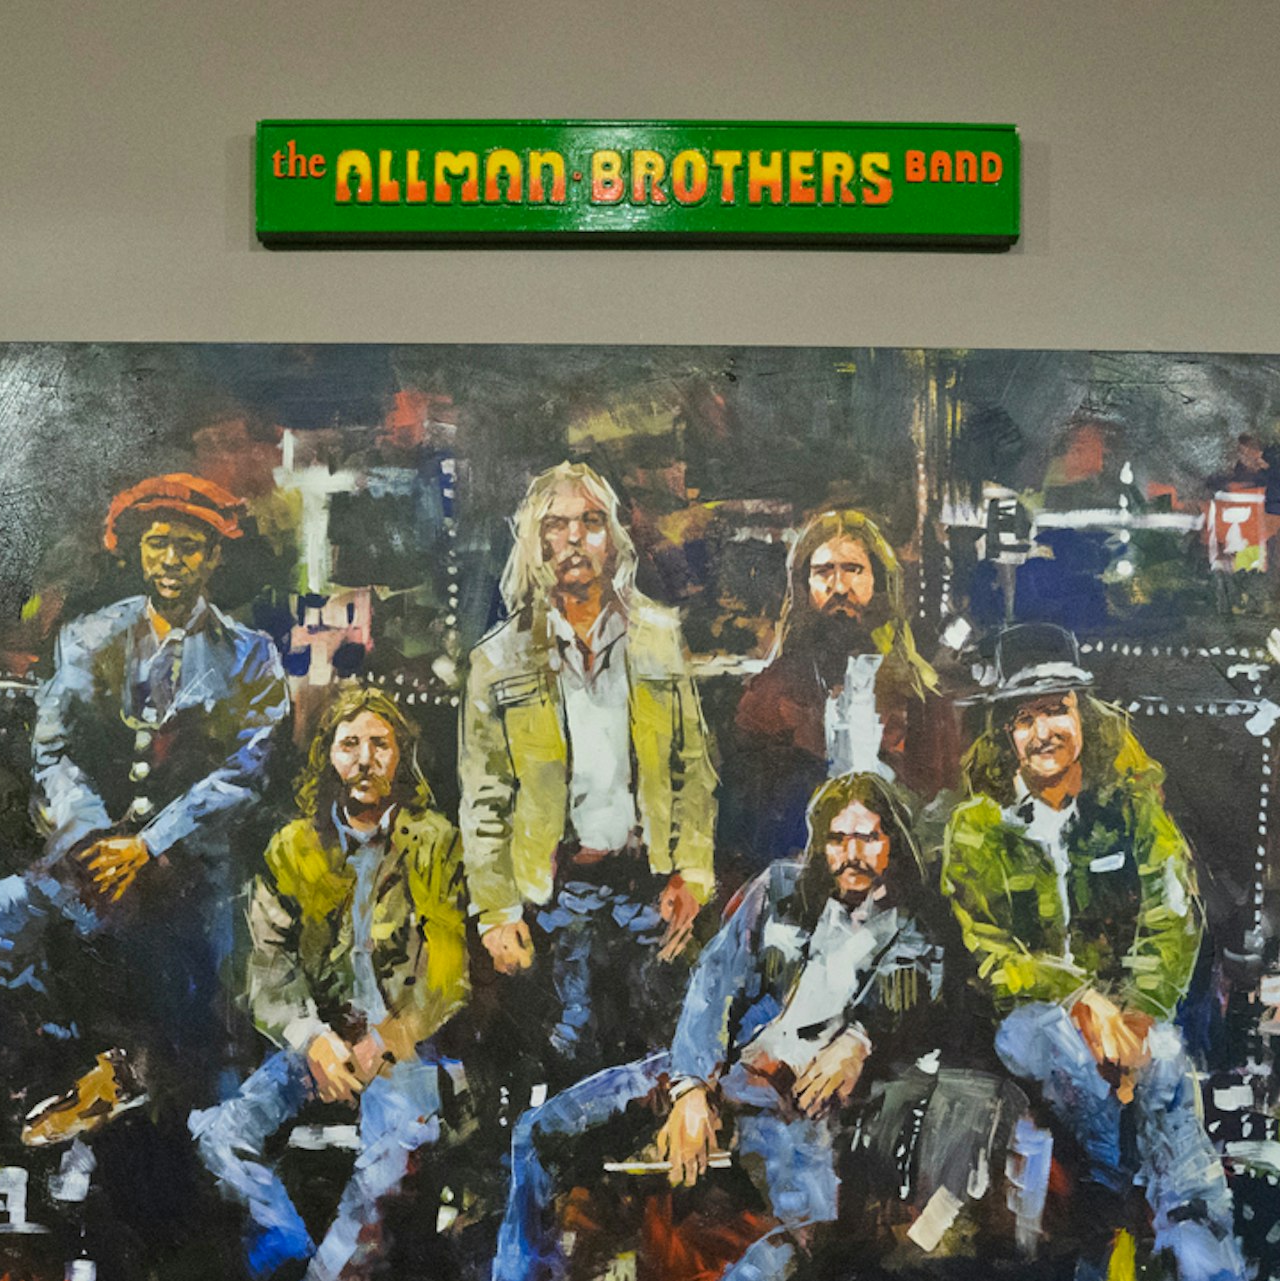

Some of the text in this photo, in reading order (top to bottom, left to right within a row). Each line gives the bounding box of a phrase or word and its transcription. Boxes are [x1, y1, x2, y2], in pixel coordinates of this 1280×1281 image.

[271, 139, 1004, 207] the ALLMAN BROTHERS BAND
